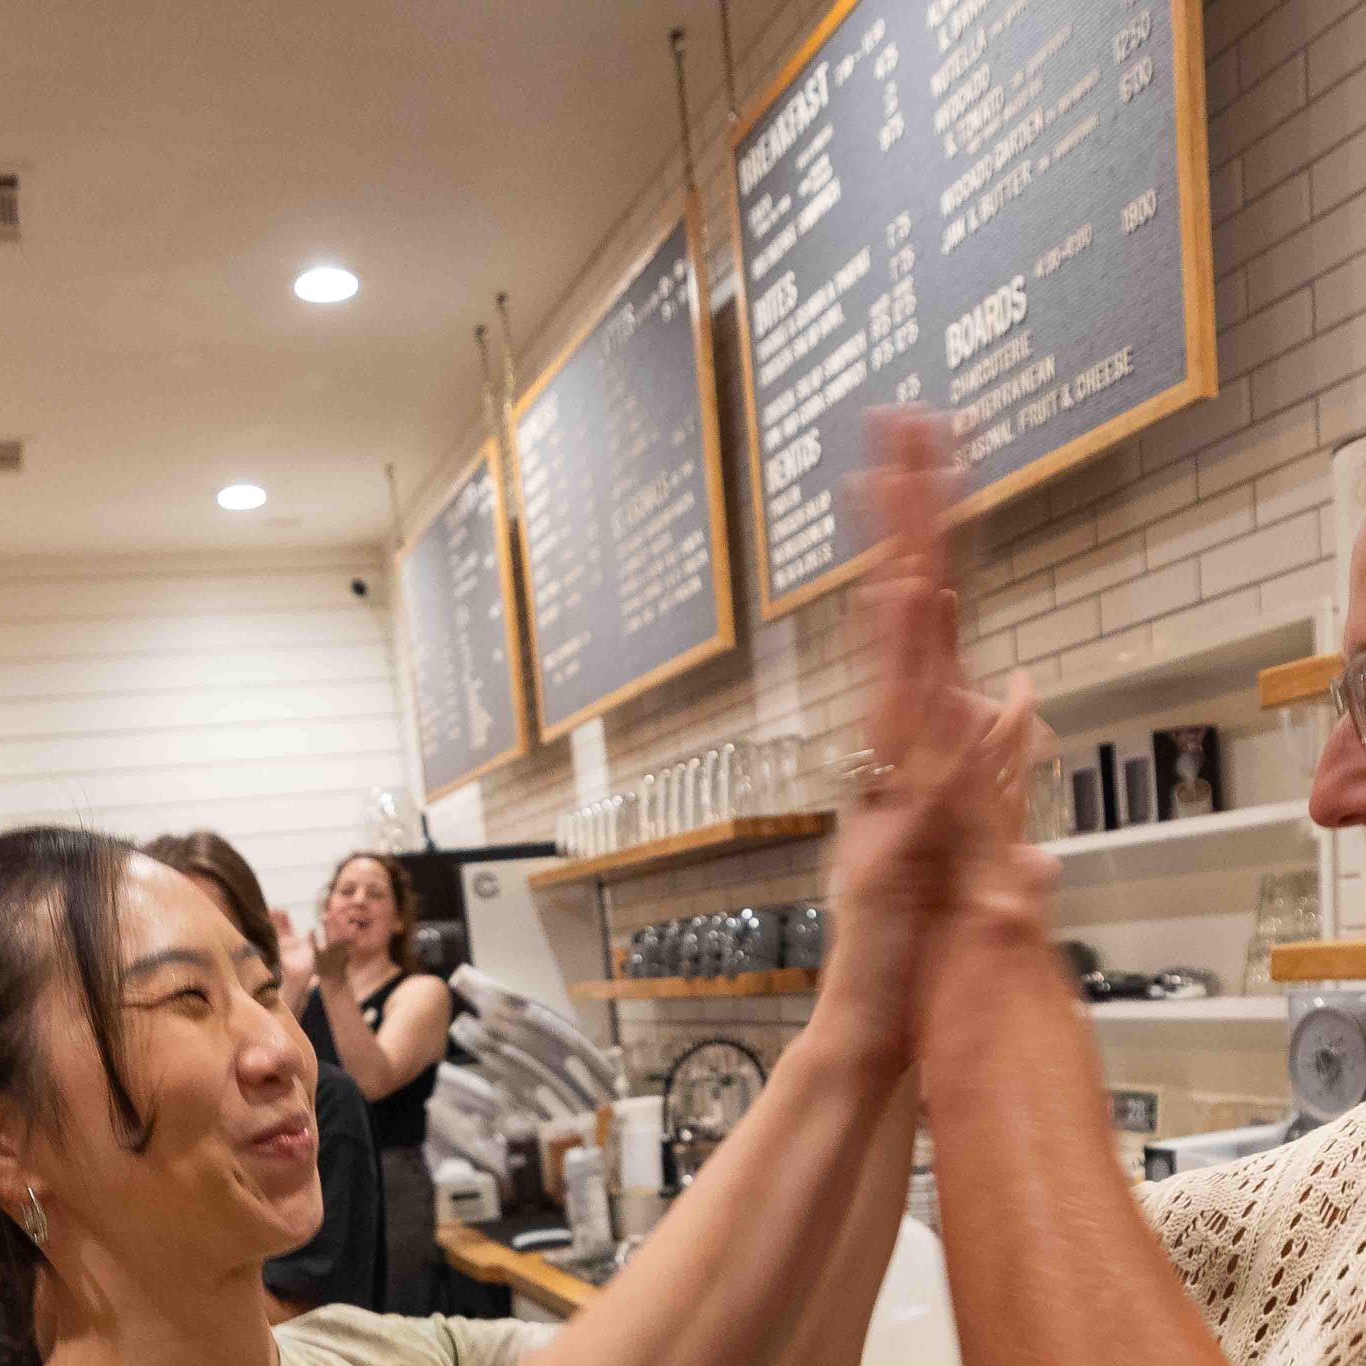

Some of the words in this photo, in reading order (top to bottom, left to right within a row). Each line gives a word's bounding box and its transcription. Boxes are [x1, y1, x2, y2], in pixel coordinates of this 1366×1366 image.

[945, 274, 1027, 370] BOARDS
[1017, 390, 1059, 434] FRUIT
[1075, 344, 1136, 402] CHEESE
